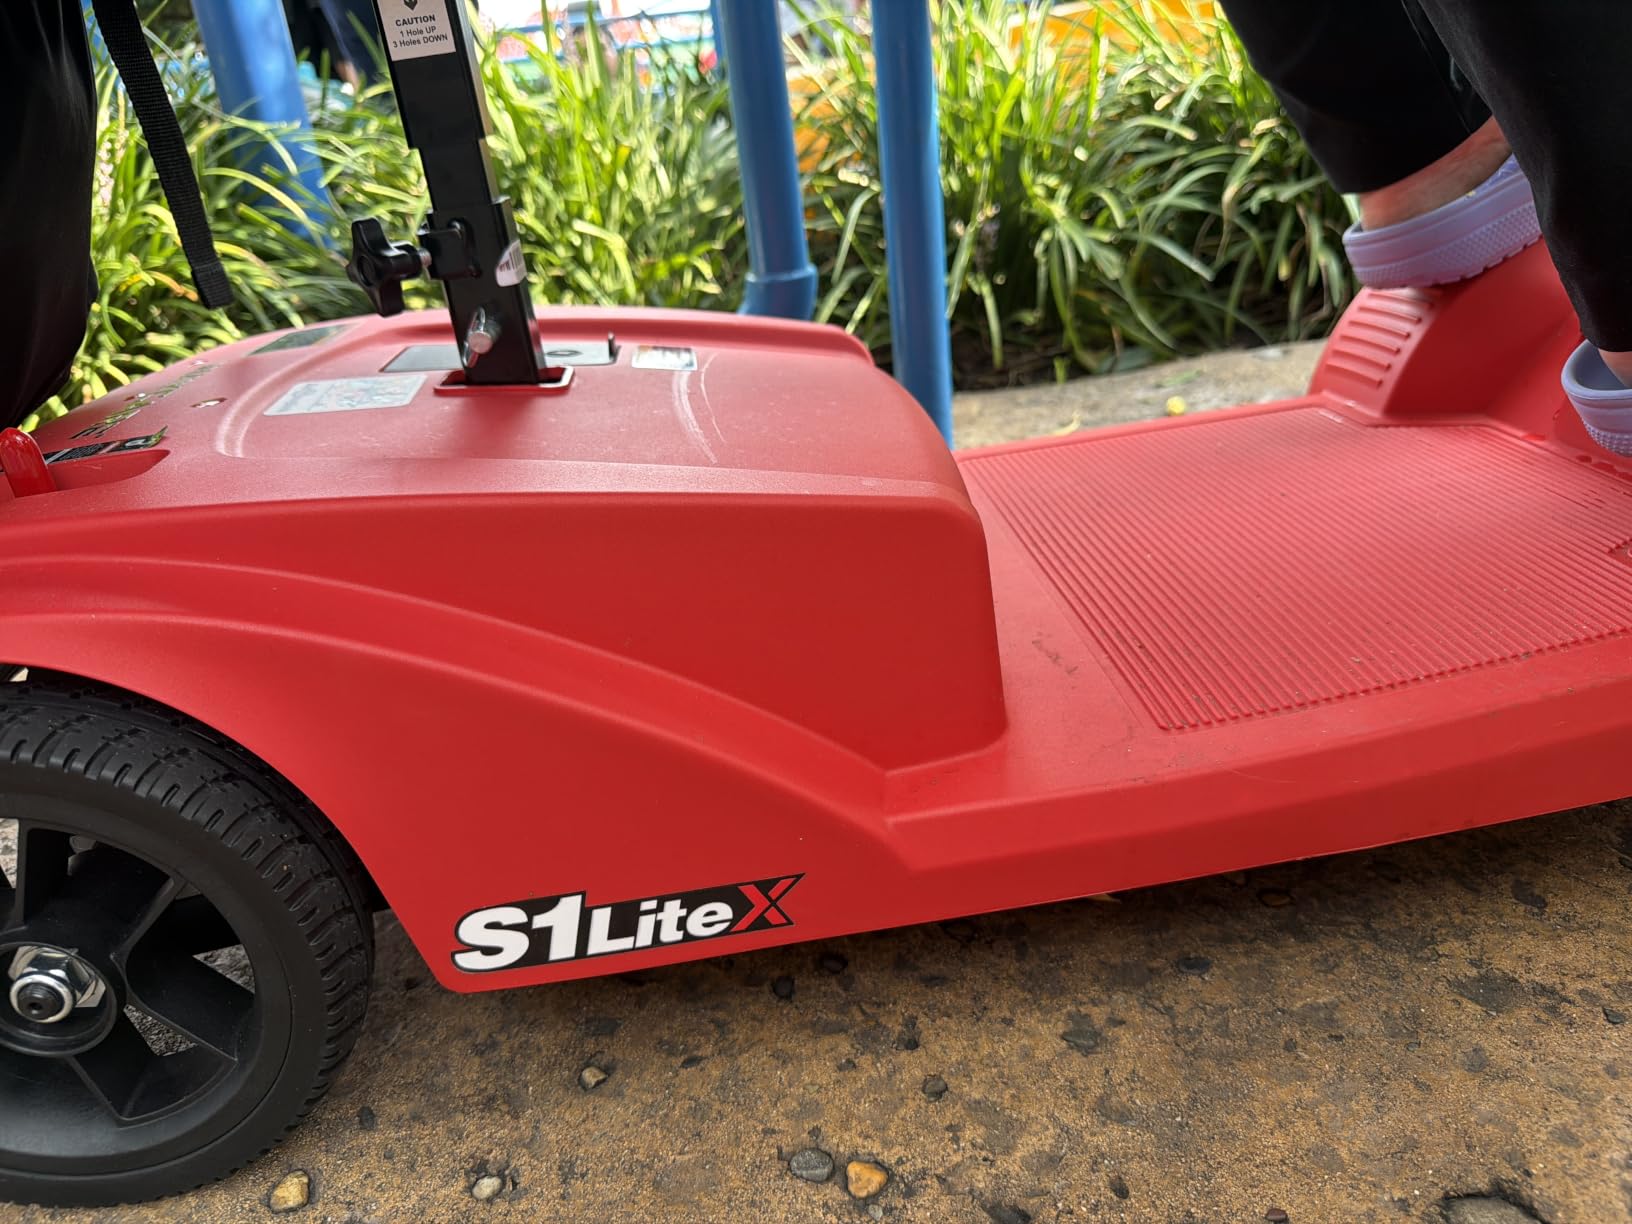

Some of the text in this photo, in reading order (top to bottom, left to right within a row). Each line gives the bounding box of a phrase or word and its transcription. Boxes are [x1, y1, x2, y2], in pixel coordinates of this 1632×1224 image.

[395, 14, 436, 27] CAUTION
[406, 28, 424, 37] Hole
[425, 26, 437, 34] UP
[399, 38, 421, 47] Holes
[422, 33, 448, 44] DOWN
